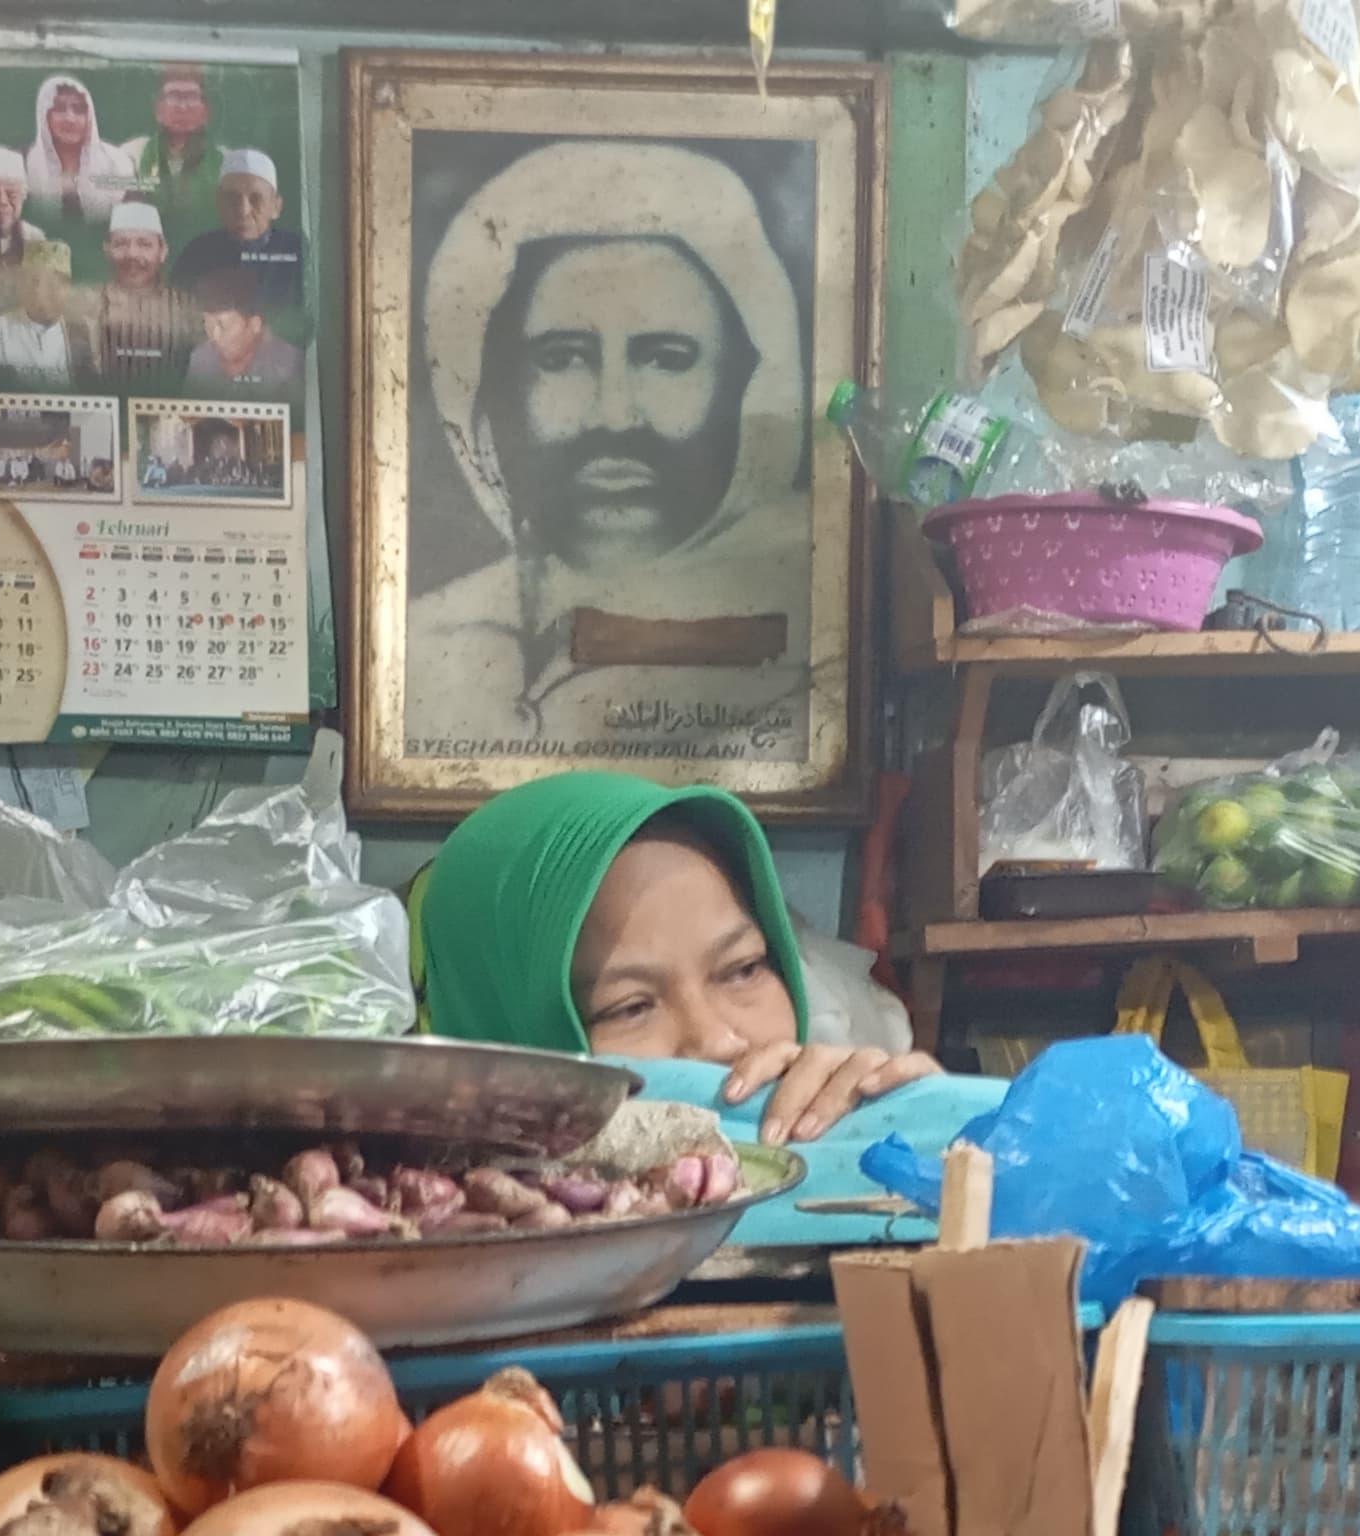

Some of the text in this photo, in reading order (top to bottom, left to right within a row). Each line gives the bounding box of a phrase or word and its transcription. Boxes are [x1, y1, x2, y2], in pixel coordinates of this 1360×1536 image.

[96, 519, 169, 537] Februari
[274, 569, 279, 581] 1
[20, 593, 29, 605] 4
[86, 587, 281, 606] 2 3 4 5 6 7 8
[18, 618, 32, 631] 11
[86, 612, 286, 630] 9 10 11 12 13 14 15
[18, 643, 34, 656] 18
[84, 637, 286, 654] 16 17 18 19 20 21 22
[16, 668, 34, 682] 25
[83, 662, 256, 679] 23 24 25 26 27 28
[406, 738, 487, 756] SYECH
[489, 738, 568, 758] ABDUL
